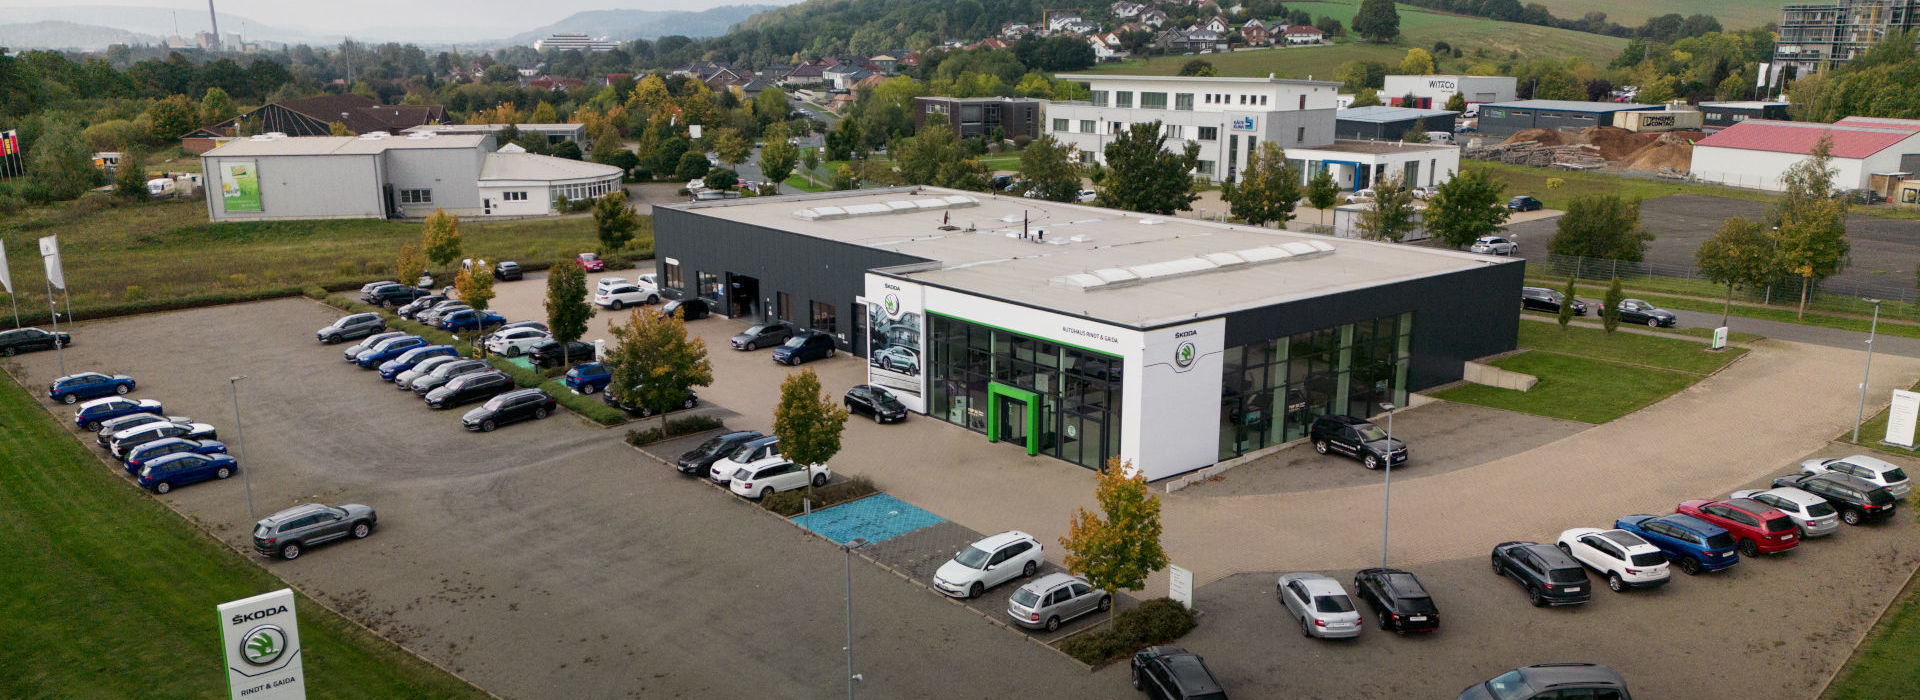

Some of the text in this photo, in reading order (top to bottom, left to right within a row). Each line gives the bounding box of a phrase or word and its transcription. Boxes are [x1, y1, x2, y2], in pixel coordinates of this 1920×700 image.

[1062, 326, 1086, 337] AUTOHAUS
[1086, 331, 1100, 340] RINDT
[1104, 335, 1119, 344] GAIDA
[1174, 329, 1198, 339] ŠKODA
[232, 605, 288, 625] ŠKODA
[241, 676, 296, 697] RINDT & GAIDA
